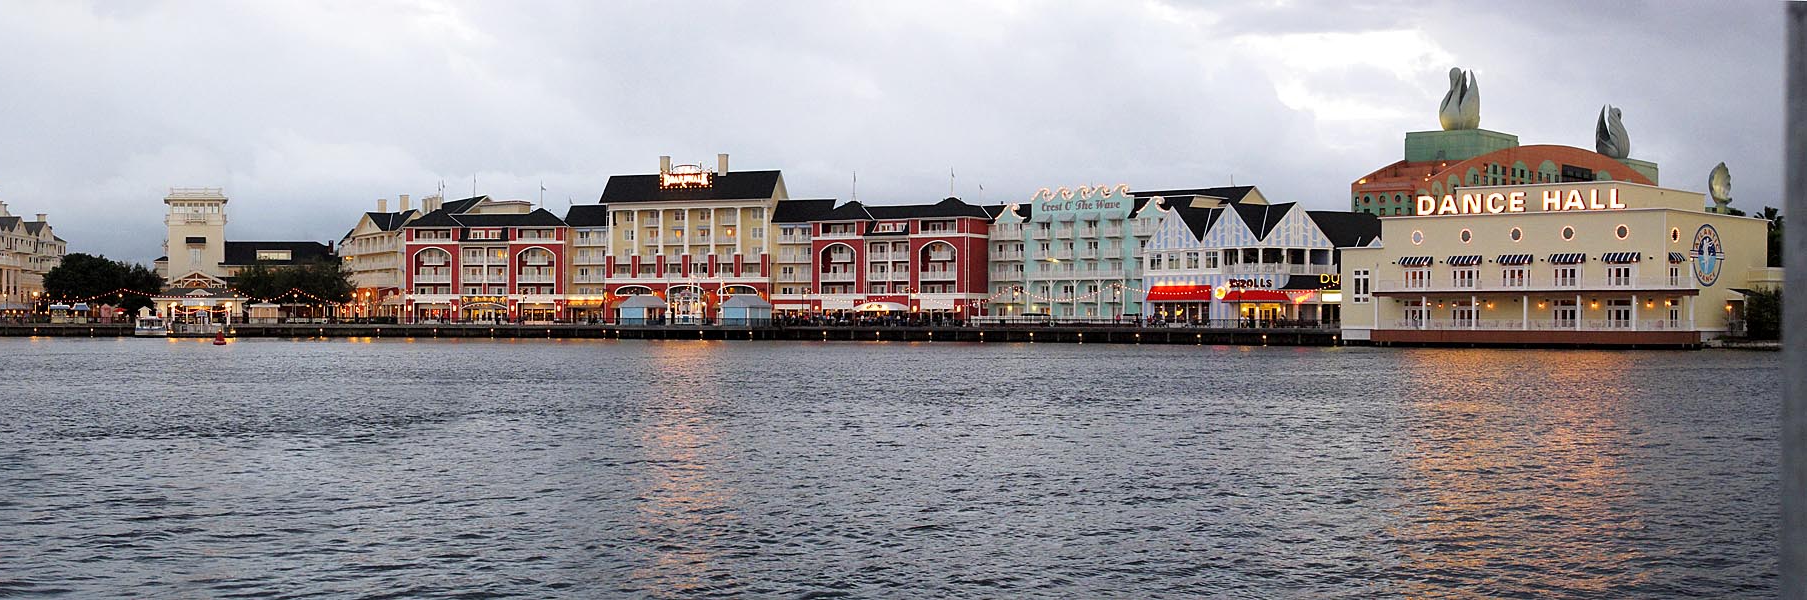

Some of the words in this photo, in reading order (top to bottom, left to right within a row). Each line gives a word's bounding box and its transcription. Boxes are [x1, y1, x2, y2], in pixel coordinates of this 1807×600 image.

[1041, 201, 1063, 212] Crest
[1074, 199, 1094, 210] The
[1096, 199, 1121, 209] Wave
[1416, 191, 1527, 216] DANCE
[1542, 188, 1627, 212] HALL
[1695, 228, 1720, 250] ATLANTIC
[1698, 270, 1716, 282] DANCE
